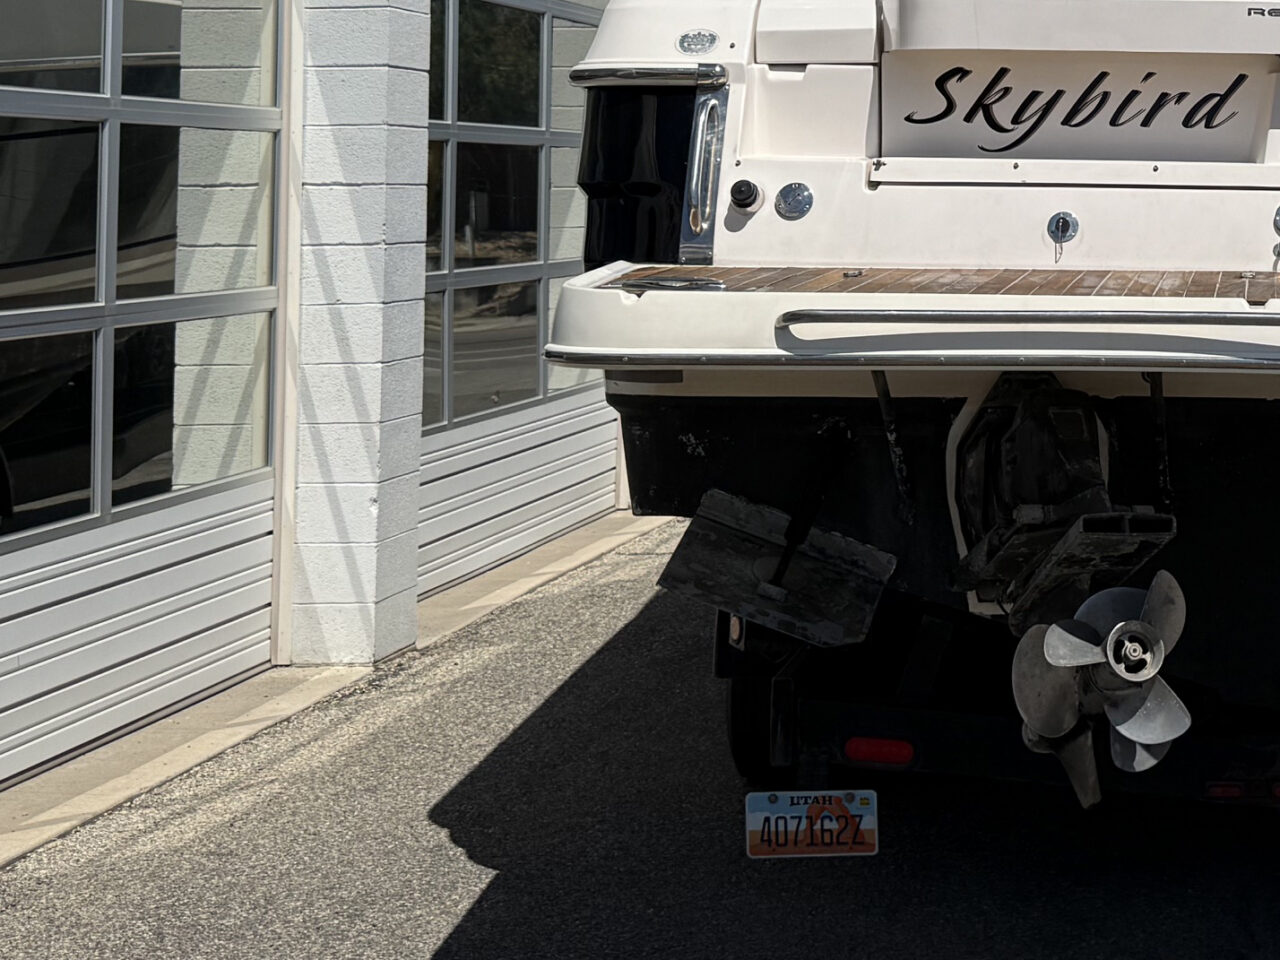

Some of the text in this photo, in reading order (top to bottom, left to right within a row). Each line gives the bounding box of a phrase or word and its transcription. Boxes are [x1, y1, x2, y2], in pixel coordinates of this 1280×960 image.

[904, 66, 1249, 152] Skybird
[789, 795, 833, 806] UTAH
[760, 815, 865, 847] 407162Z
